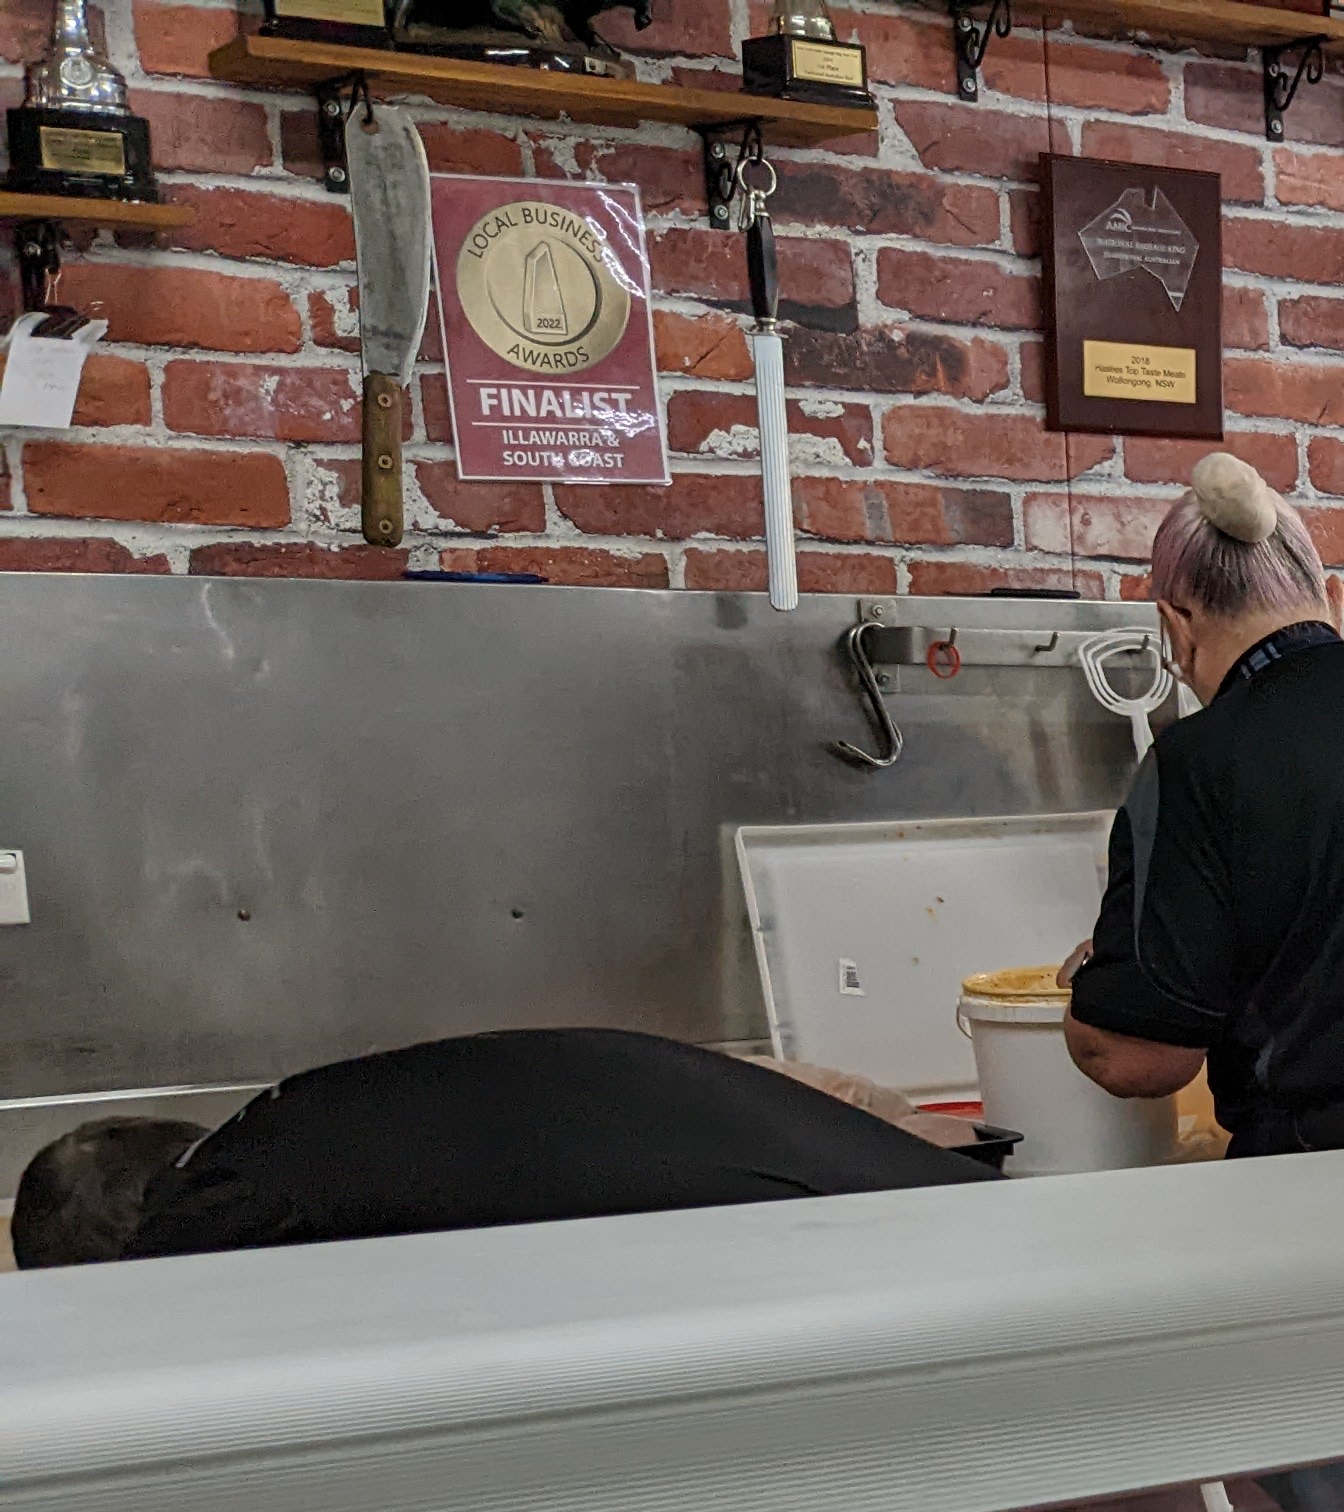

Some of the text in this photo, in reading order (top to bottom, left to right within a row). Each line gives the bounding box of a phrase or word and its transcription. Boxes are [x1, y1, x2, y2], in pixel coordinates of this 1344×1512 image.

[467, 207, 603, 262] LOCAL BUSINESS
[507, 343, 590, 369] AWARDS
[1126, 366, 1161, 377] Top Taste
[1156, 378, 1176, 388] NSW
[479, 387, 632, 419] FINALIST
[502, 430, 619, 447] ILLAWARRA &
[502, 450, 625, 468] SOUTH COAST
